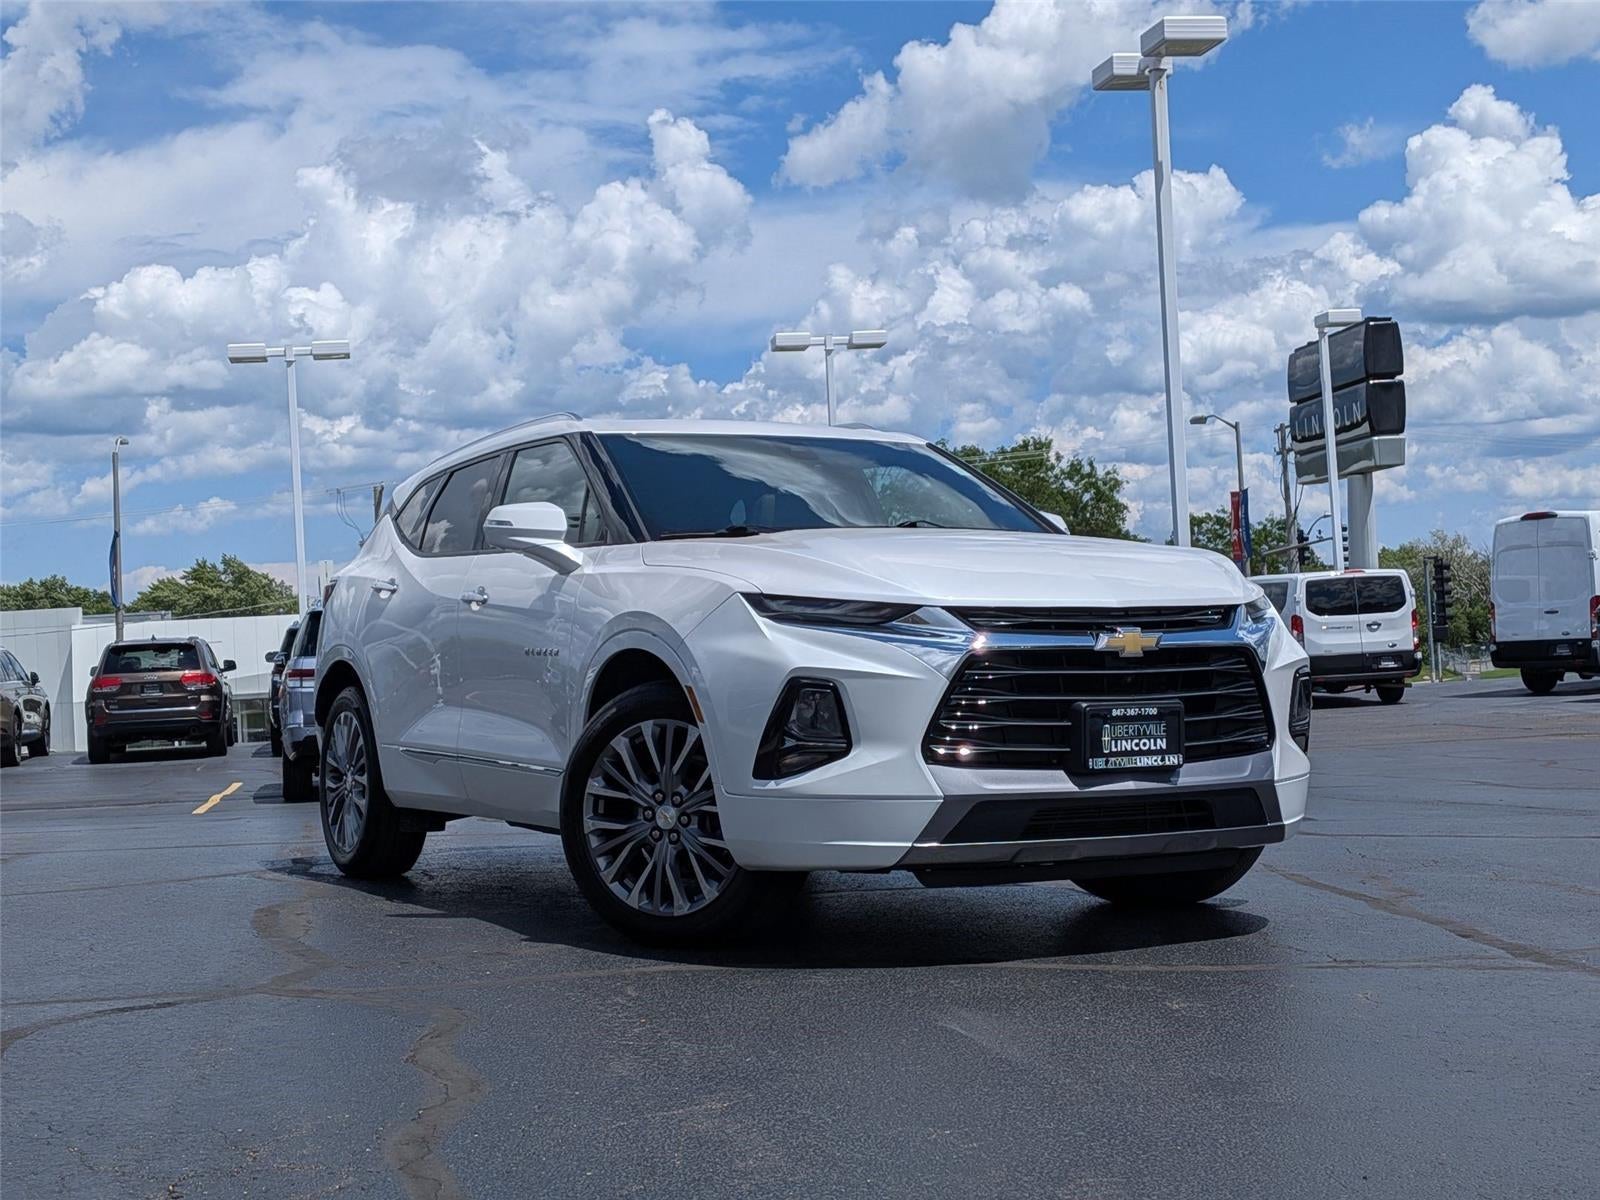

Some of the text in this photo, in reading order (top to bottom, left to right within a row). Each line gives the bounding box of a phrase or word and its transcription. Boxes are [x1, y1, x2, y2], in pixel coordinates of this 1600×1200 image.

[1295, 401, 1362, 440] LINOLN
[1111, 707, 1158, 717] 847-367-1700
[1111, 723, 1167, 737] LIBERTYVILLE
[1111, 738, 1167, 752] LINCOLN
